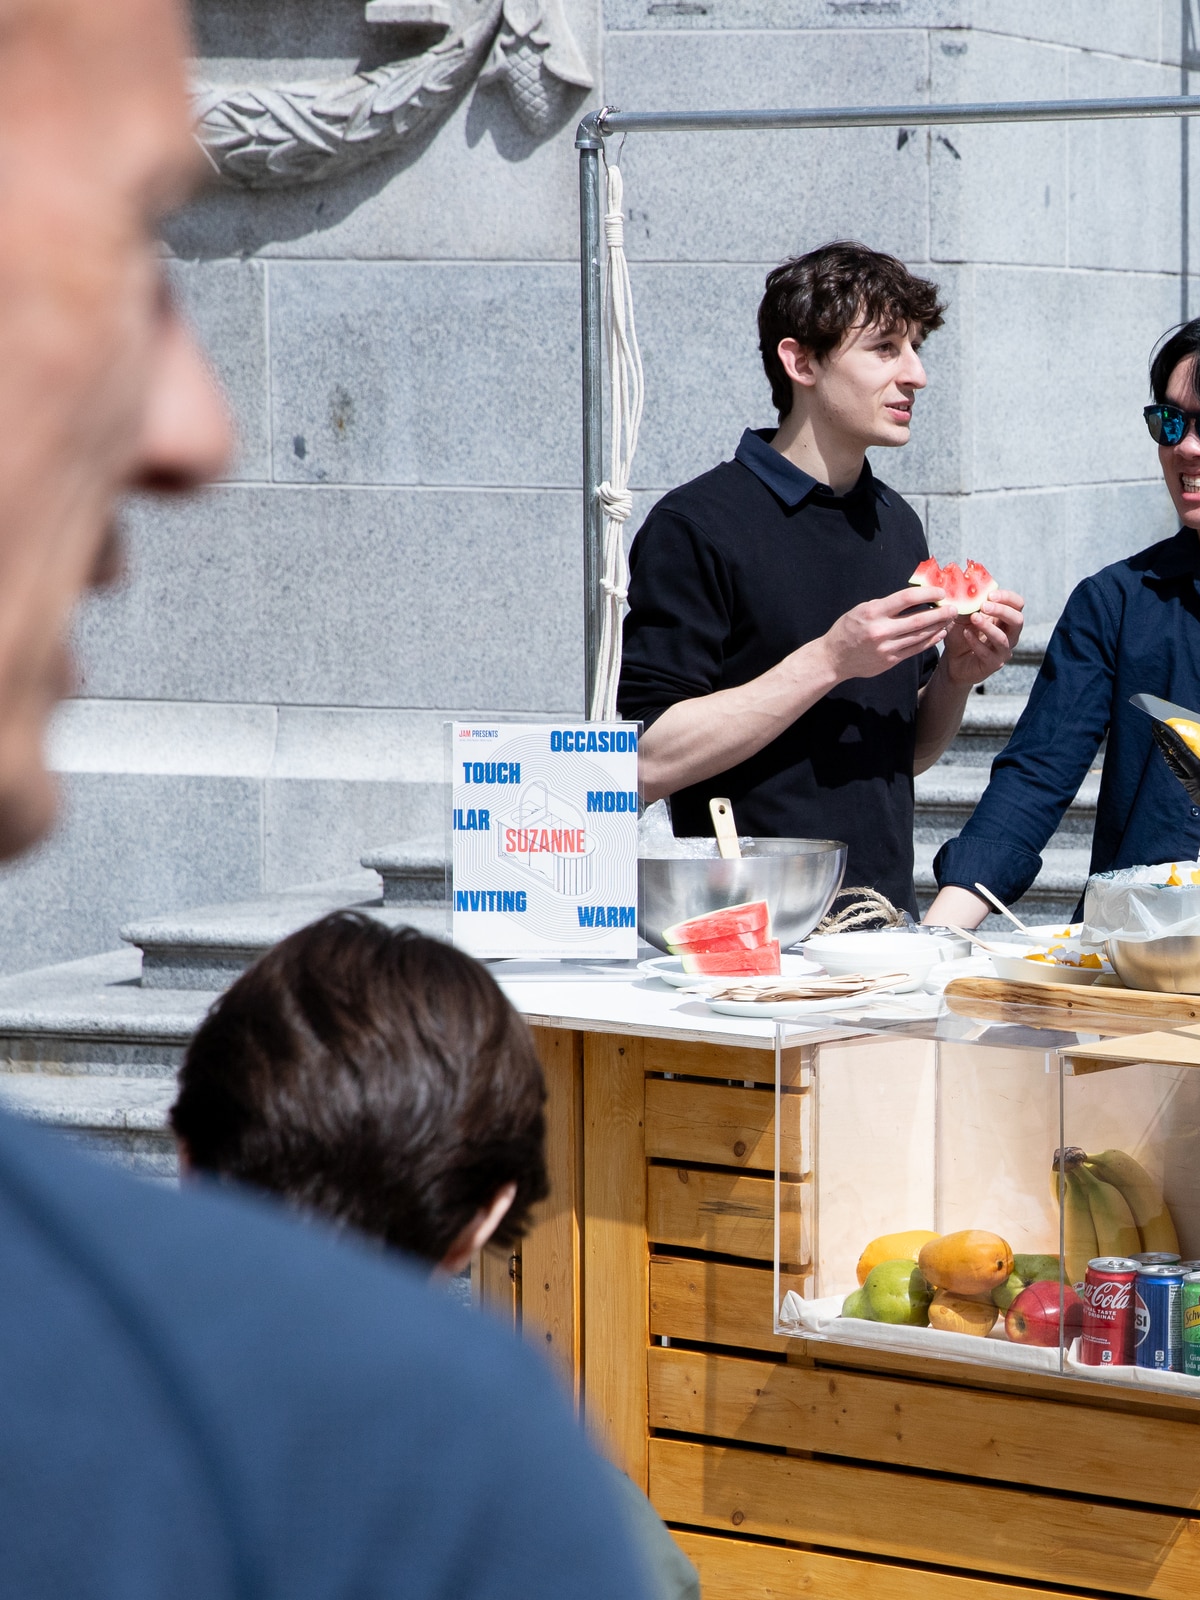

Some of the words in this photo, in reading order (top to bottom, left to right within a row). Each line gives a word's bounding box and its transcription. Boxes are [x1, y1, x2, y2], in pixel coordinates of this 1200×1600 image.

[551, 731, 637, 752] OCCASION
[463, 762, 521, 784] TOUCH
[587, 791, 637, 812] MODU
[505, 829, 585, 853] SUZANNE
[454, 891, 527, 911] NVITING
[577, 906, 636, 928] WARM
[1097, 1309, 1116, 1317] TASTE
